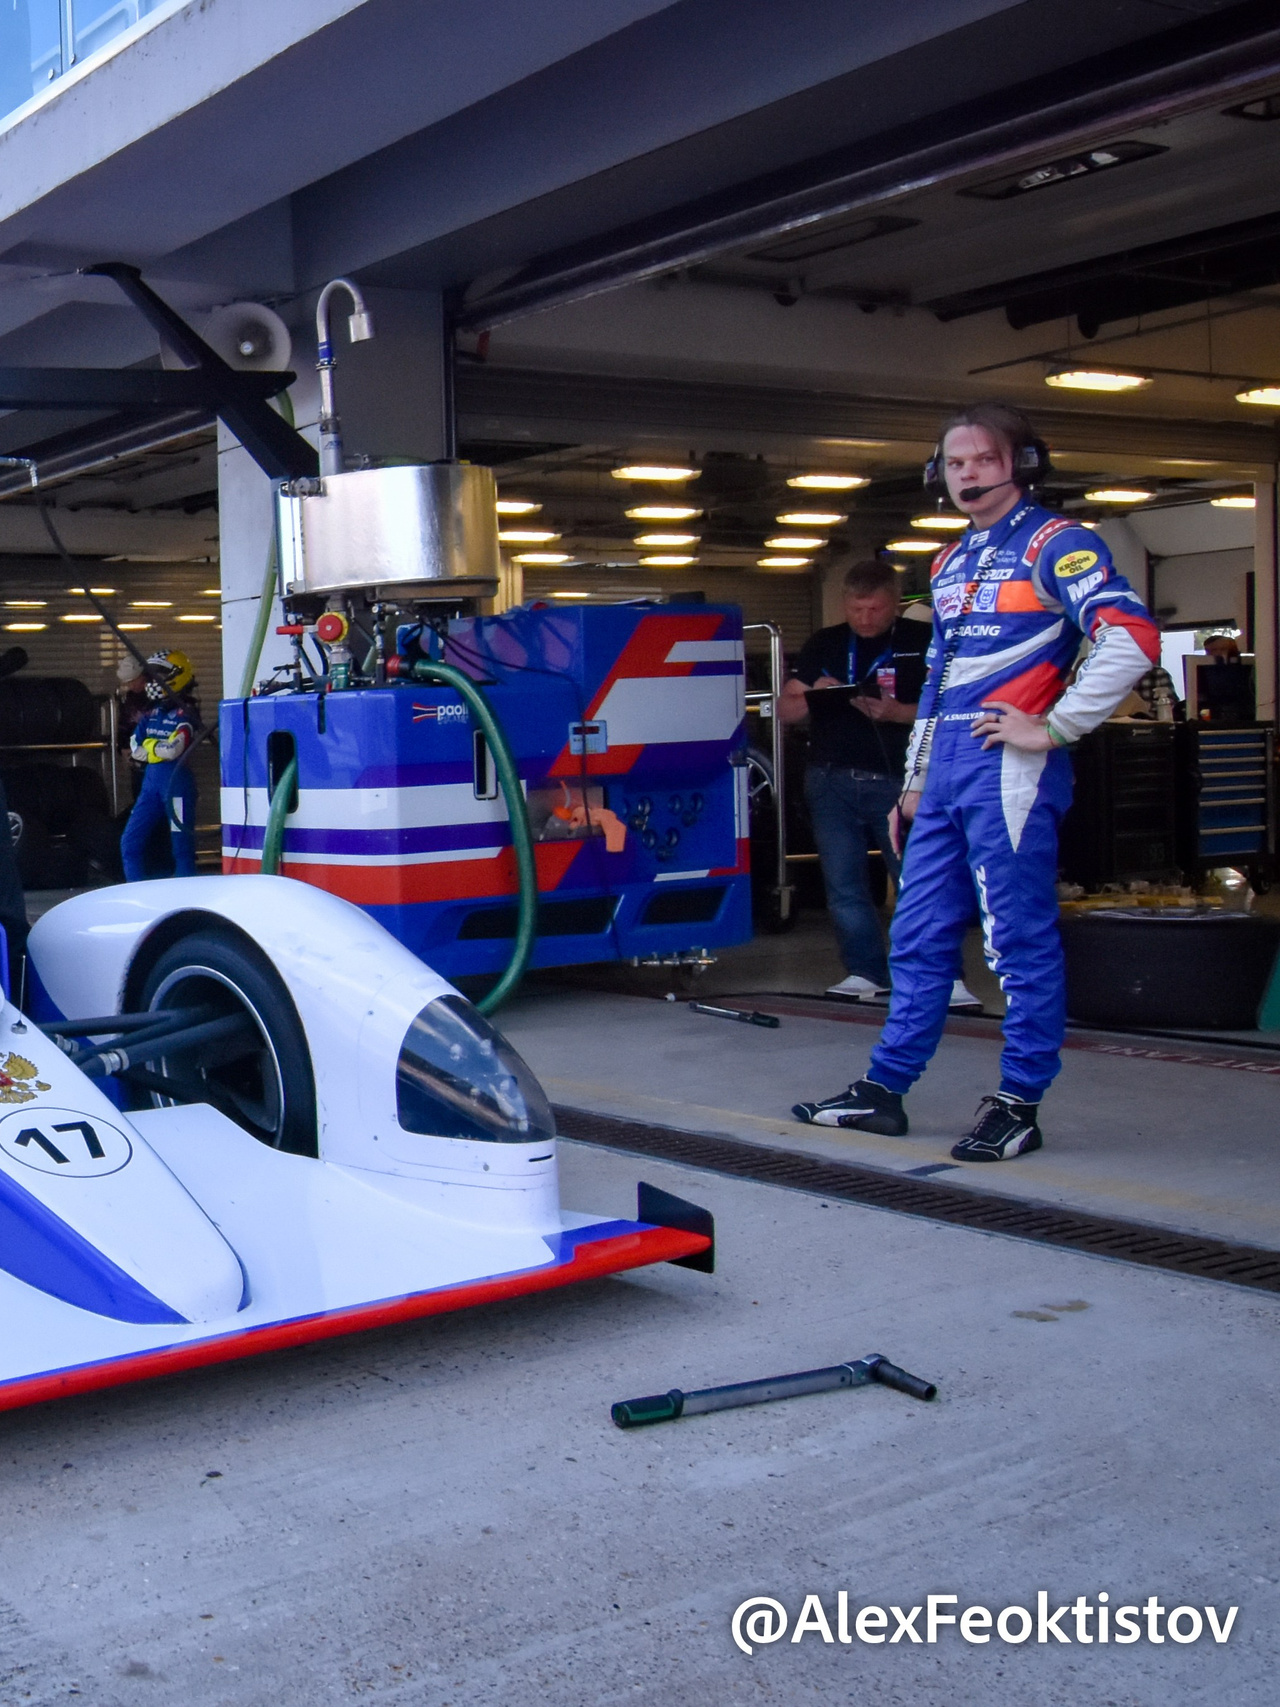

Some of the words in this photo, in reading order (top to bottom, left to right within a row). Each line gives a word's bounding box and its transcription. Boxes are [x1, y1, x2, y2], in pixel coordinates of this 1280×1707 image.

[1058, 555, 1090, 573] KROON
[1068, 565, 1084, 574] OIL
[14, 1121, 106, 1164] 17
